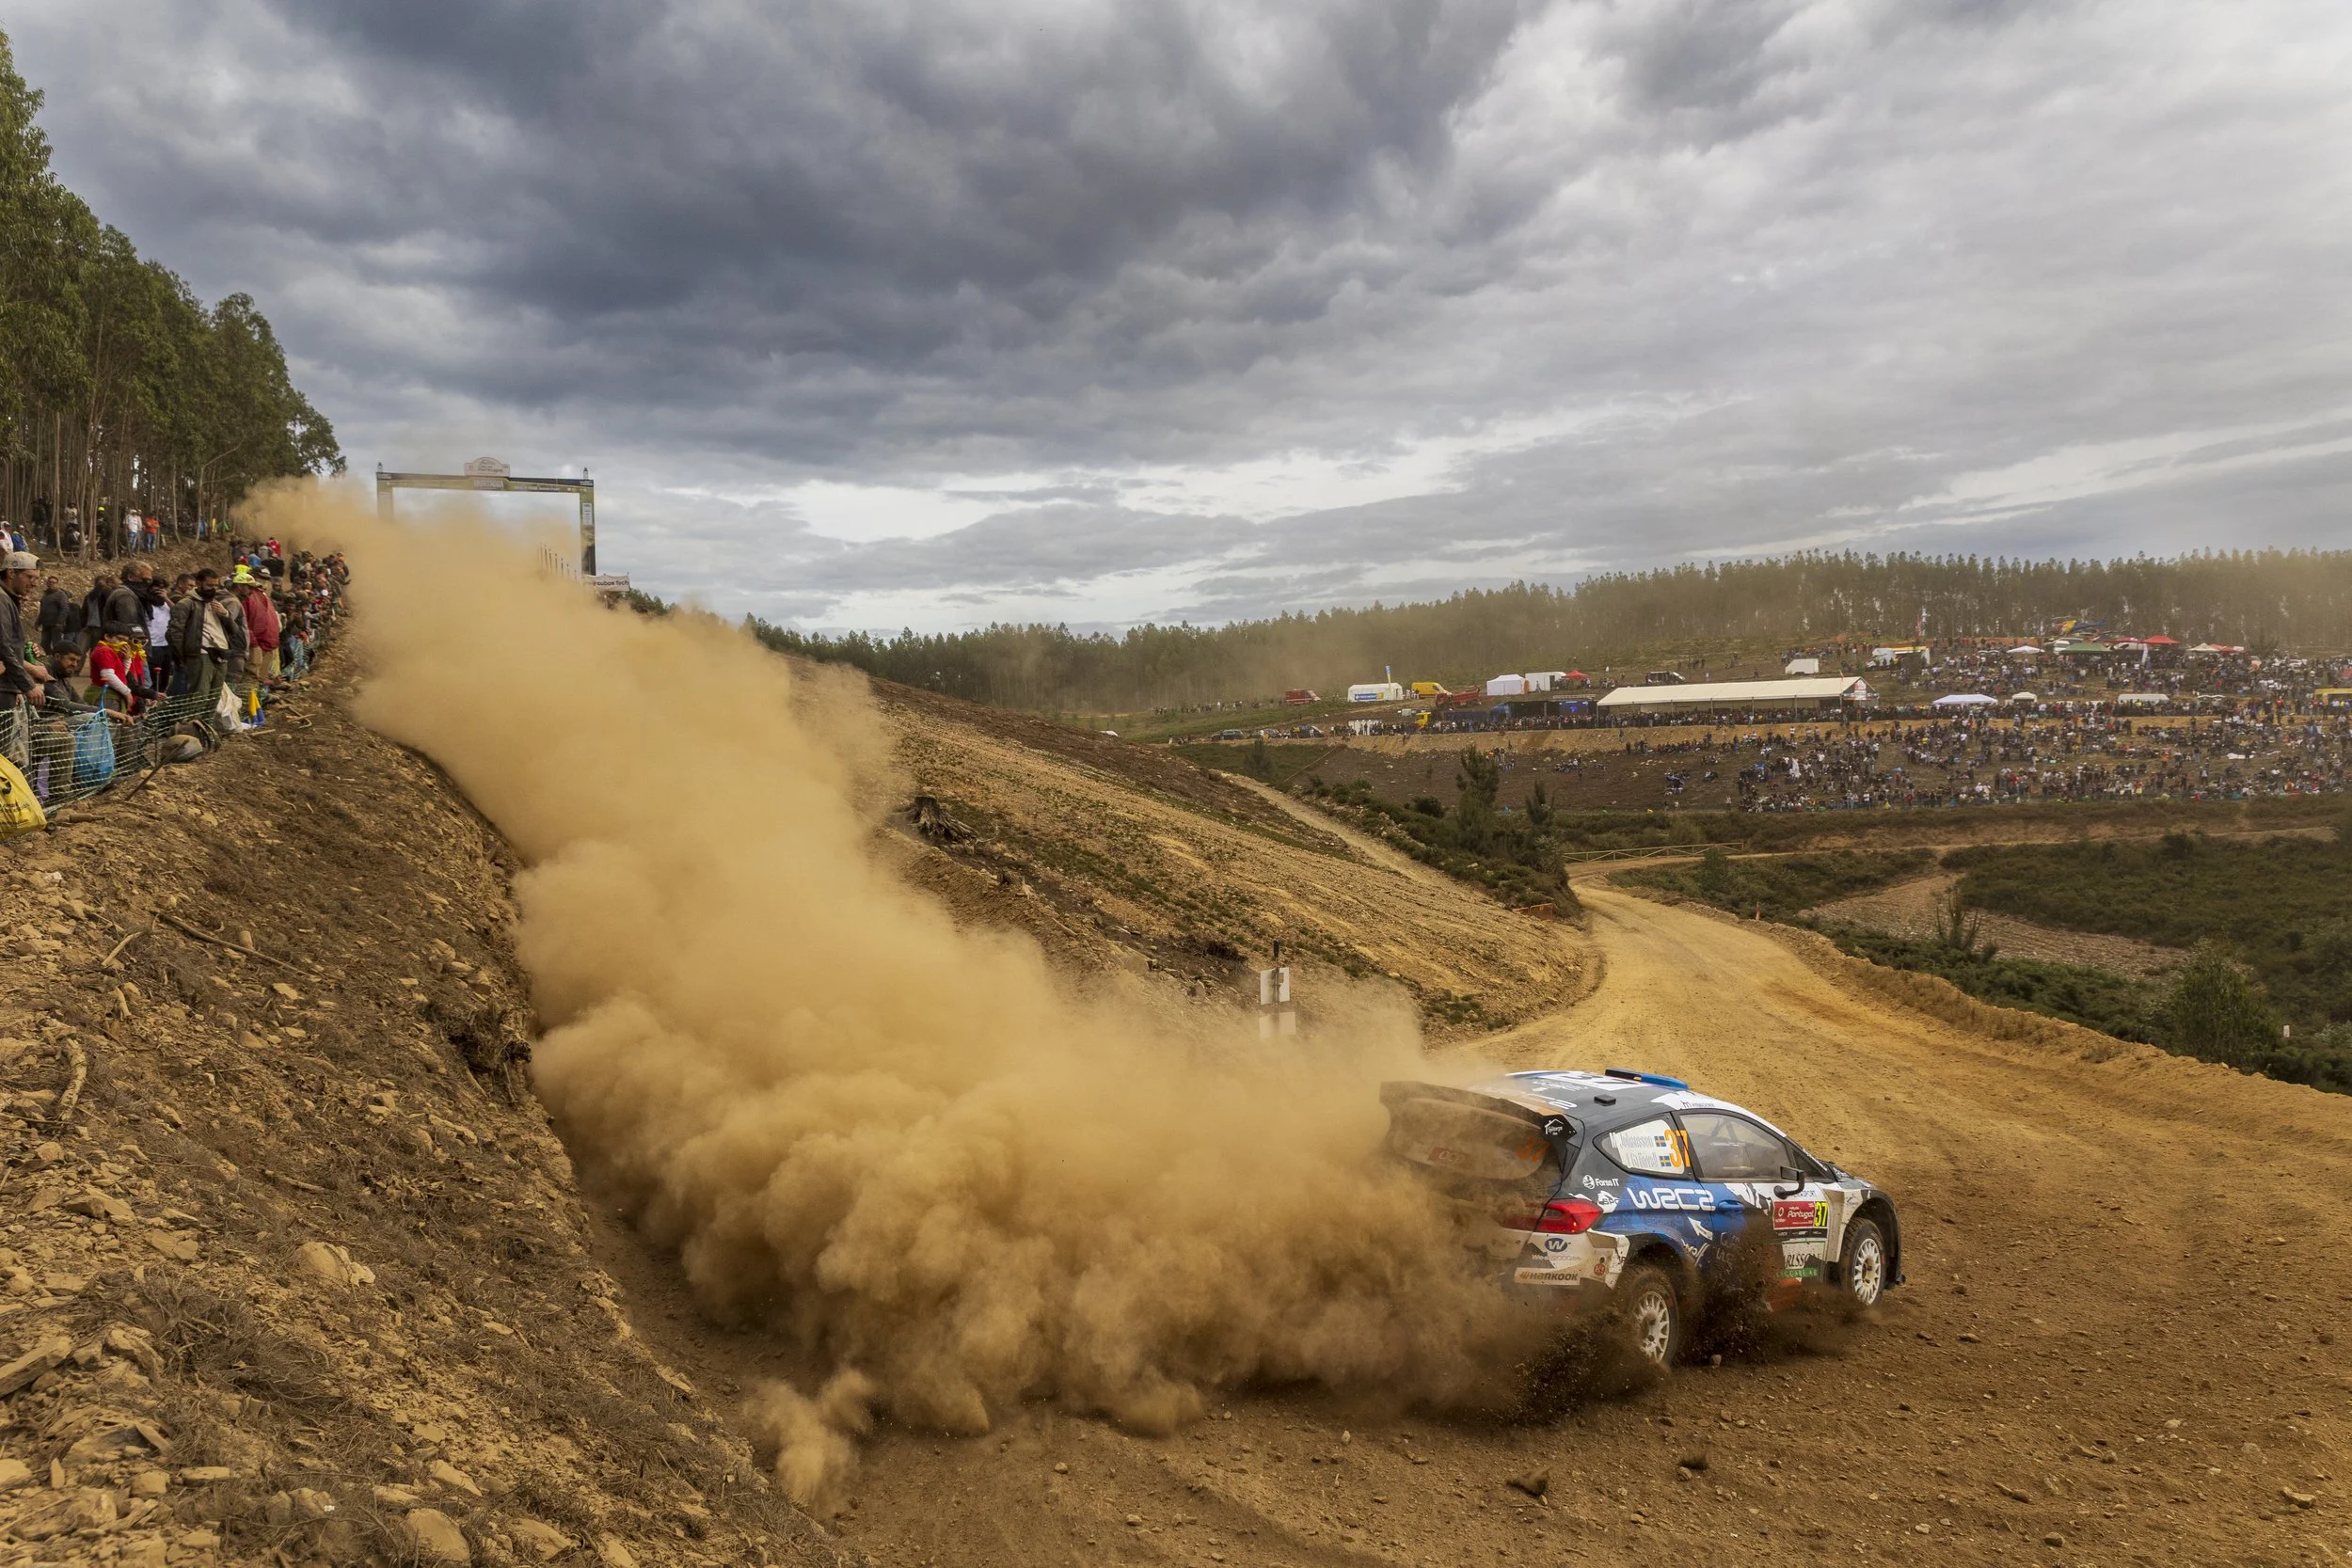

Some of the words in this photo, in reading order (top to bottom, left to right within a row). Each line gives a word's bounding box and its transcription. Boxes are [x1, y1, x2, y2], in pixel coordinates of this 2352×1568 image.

[1664, 1129, 1691, 1168] 37
[1788, 1210, 1814, 1219] Portugal
[1815, 1201, 1828, 1227] 37
